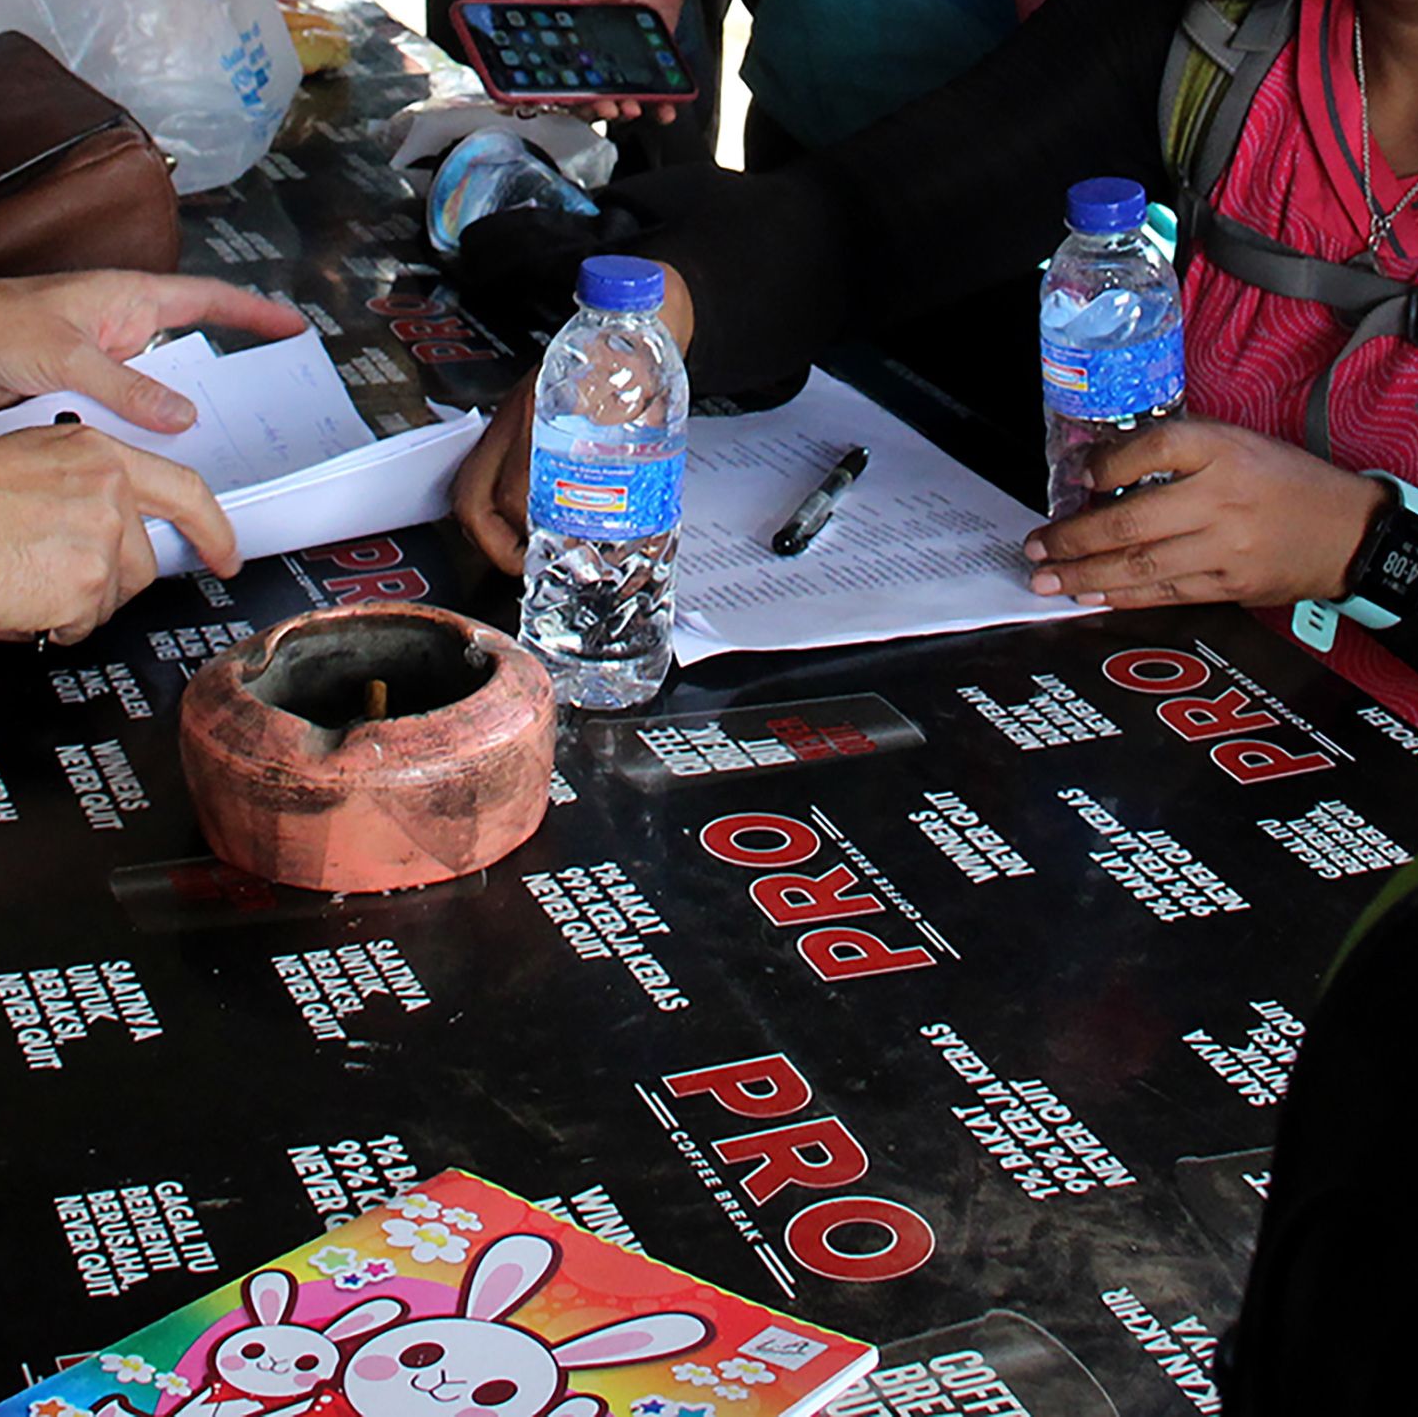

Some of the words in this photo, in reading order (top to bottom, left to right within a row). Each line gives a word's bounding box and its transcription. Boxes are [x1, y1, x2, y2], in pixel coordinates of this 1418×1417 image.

[300, 535, 431, 608] PR
[1031, 673, 1077, 702] QUIT
[956, 685, 1047, 751] MENYERAH
[1007, 703, 1071, 746] BUKAN
[1064, 698, 1123, 737] NEVER
[1101, 647, 1337, 785] PRO
[54, 743, 105, 796] NEVER
[90, 738, 152, 812] WINNERS
[635, 725, 714, 776] COFFEE
[737, 737, 799, 767] BUT
[79, 791, 125, 830] QUIT
[922, 790, 981, 827] QUIT
[1056, 787, 1127, 835] KERAS
[1255, 817, 1294, 840] ITU
[1318, 798, 1367, 828] QUIT
[907, 809, 999, 885] WINNERS
[964, 823, 1036, 878] NEVER
[1109, 831, 1181, 883] KERJA
[1136, 829, 1193, 864] QUIT
[1283, 836, 1344, 880] GAGAL
[1286, 818, 1369, 876] BERHENTI
[1356, 822, 1415, 866] NEVER
[589, 860, 629, 887] 1%
[698, 811, 938, 982] PRO
[1088, 850, 1163, 900] BAKAT
[1162, 880, 1219, 917] 99%
[1179, 861, 1252, 913] NEVER
[520, 871, 581, 926] NEVER
[560, 920, 614, 961] QUIT
[605, 882, 672, 935] BAKAT
[1145, 896, 1187, 924] 1%
[555, 866, 605, 904] 99%
[581, 900, 646, 958] KERJA
[622, 952, 691, 1012] KERAS
[64, 963, 120, 1026] UNTUK
[270, 954, 322, 1006] NEVER
[301, 1002, 348, 1041] QUIT
[335, 943, 391, 1000] UNTUK
[365, 938, 433, 1014] SAATNYA
[99, 959, 164, 1044] SAATNYA
[1248, 1000, 1307, 1038] QUIT
[16, 1027, 64, 1071] QUIT
[919, 1021, 997, 1084] KERAS
[1181, 1028, 1278, 1107] SAATNYA
[976, 1080, 1057, 1148] KERJA
[1007, 1078, 1073, 1125] QUIT
[366, 1133, 410, 1166] 1%
[950, 1103, 1034, 1171] BAKAT
[1055, 1120, 1138, 1188] NEVER
[286, 1143, 350, 1215] NEVER
[326, 1139, 381, 1189] 99%
[660, 1051, 937, 1283] PRO
[669, 1129, 724, 1189] COFFEE
[712, 1187, 765, 1243] BREAK
[1013, 1167, 1062, 1202] 1%
[1034, 1145, 1099, 1195] 99%
[52, 1194, 101, 1256] NEVER
[119, 1184, 182, 1273] BERHENTI
[153, 1180, 205, 1245] GAGAL
[179, 1241, 221, 1274] ITU
[76, 1252, 121, 1299] QUIT
[1100, 1286, 1182, 1353] AKHIR
